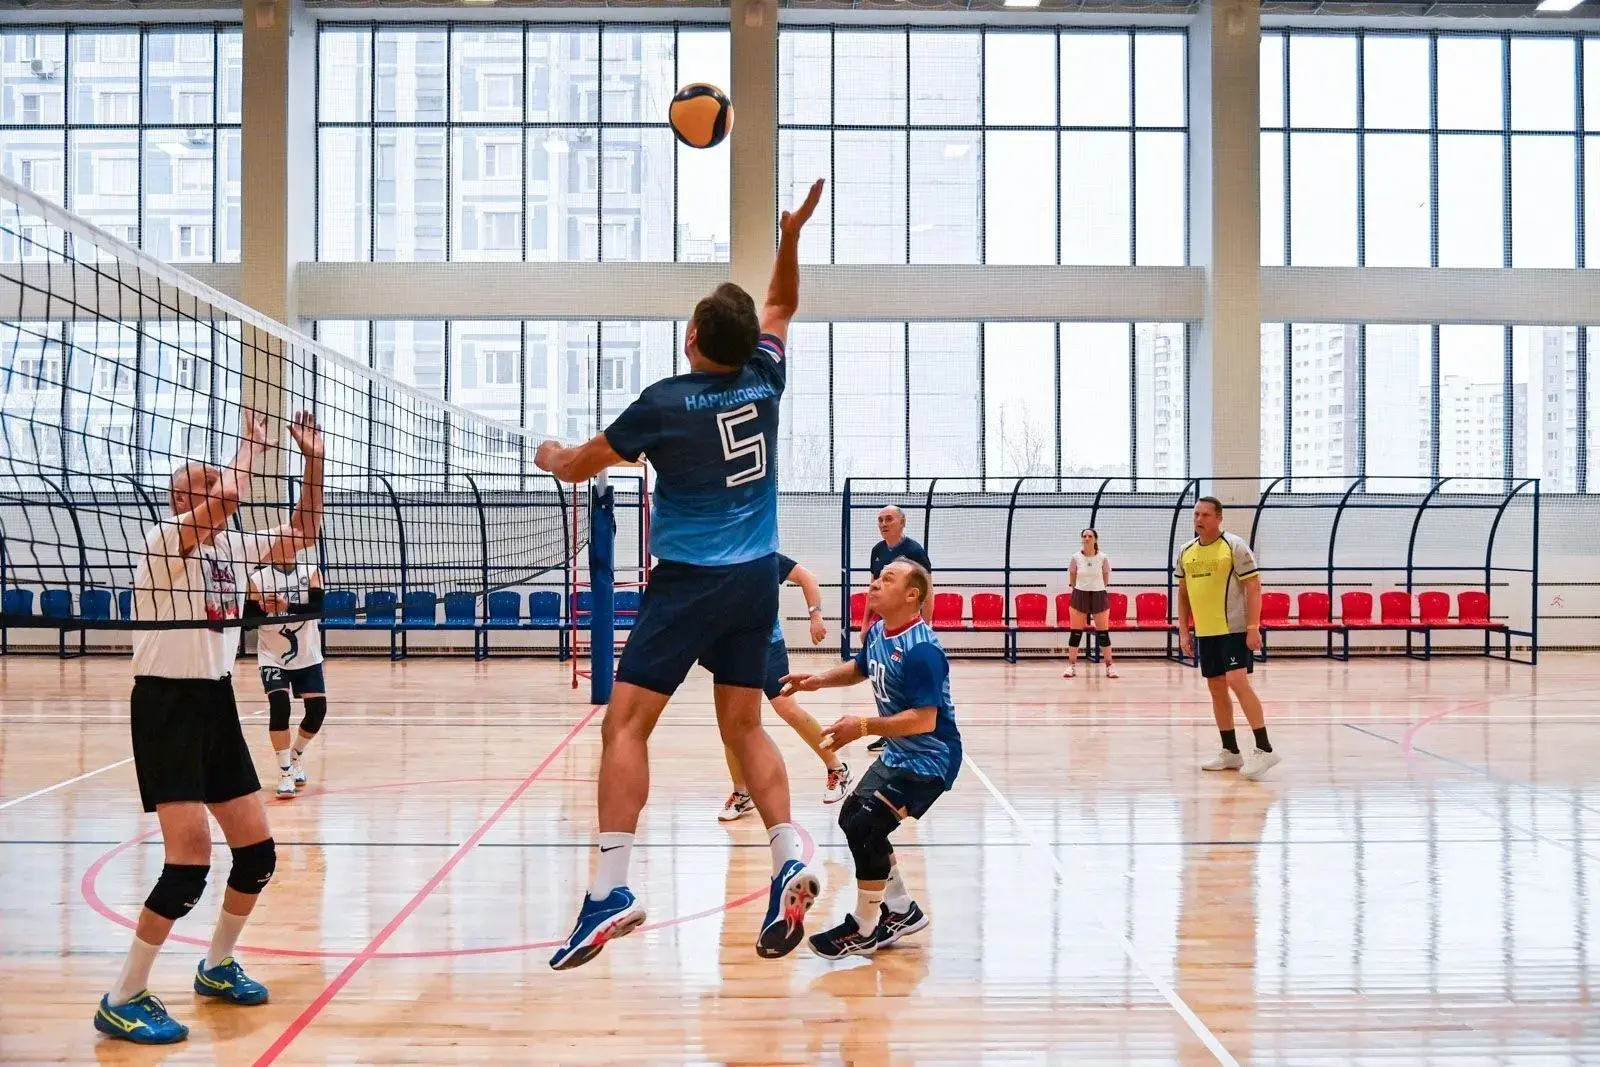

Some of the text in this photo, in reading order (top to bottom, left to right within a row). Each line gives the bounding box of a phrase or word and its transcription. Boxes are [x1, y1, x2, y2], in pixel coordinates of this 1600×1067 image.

[685, 383, 776, 411] НАРИНОВИЧ
[717, 402, 766, 488] 5
[263, 667, 282, 682] 72
